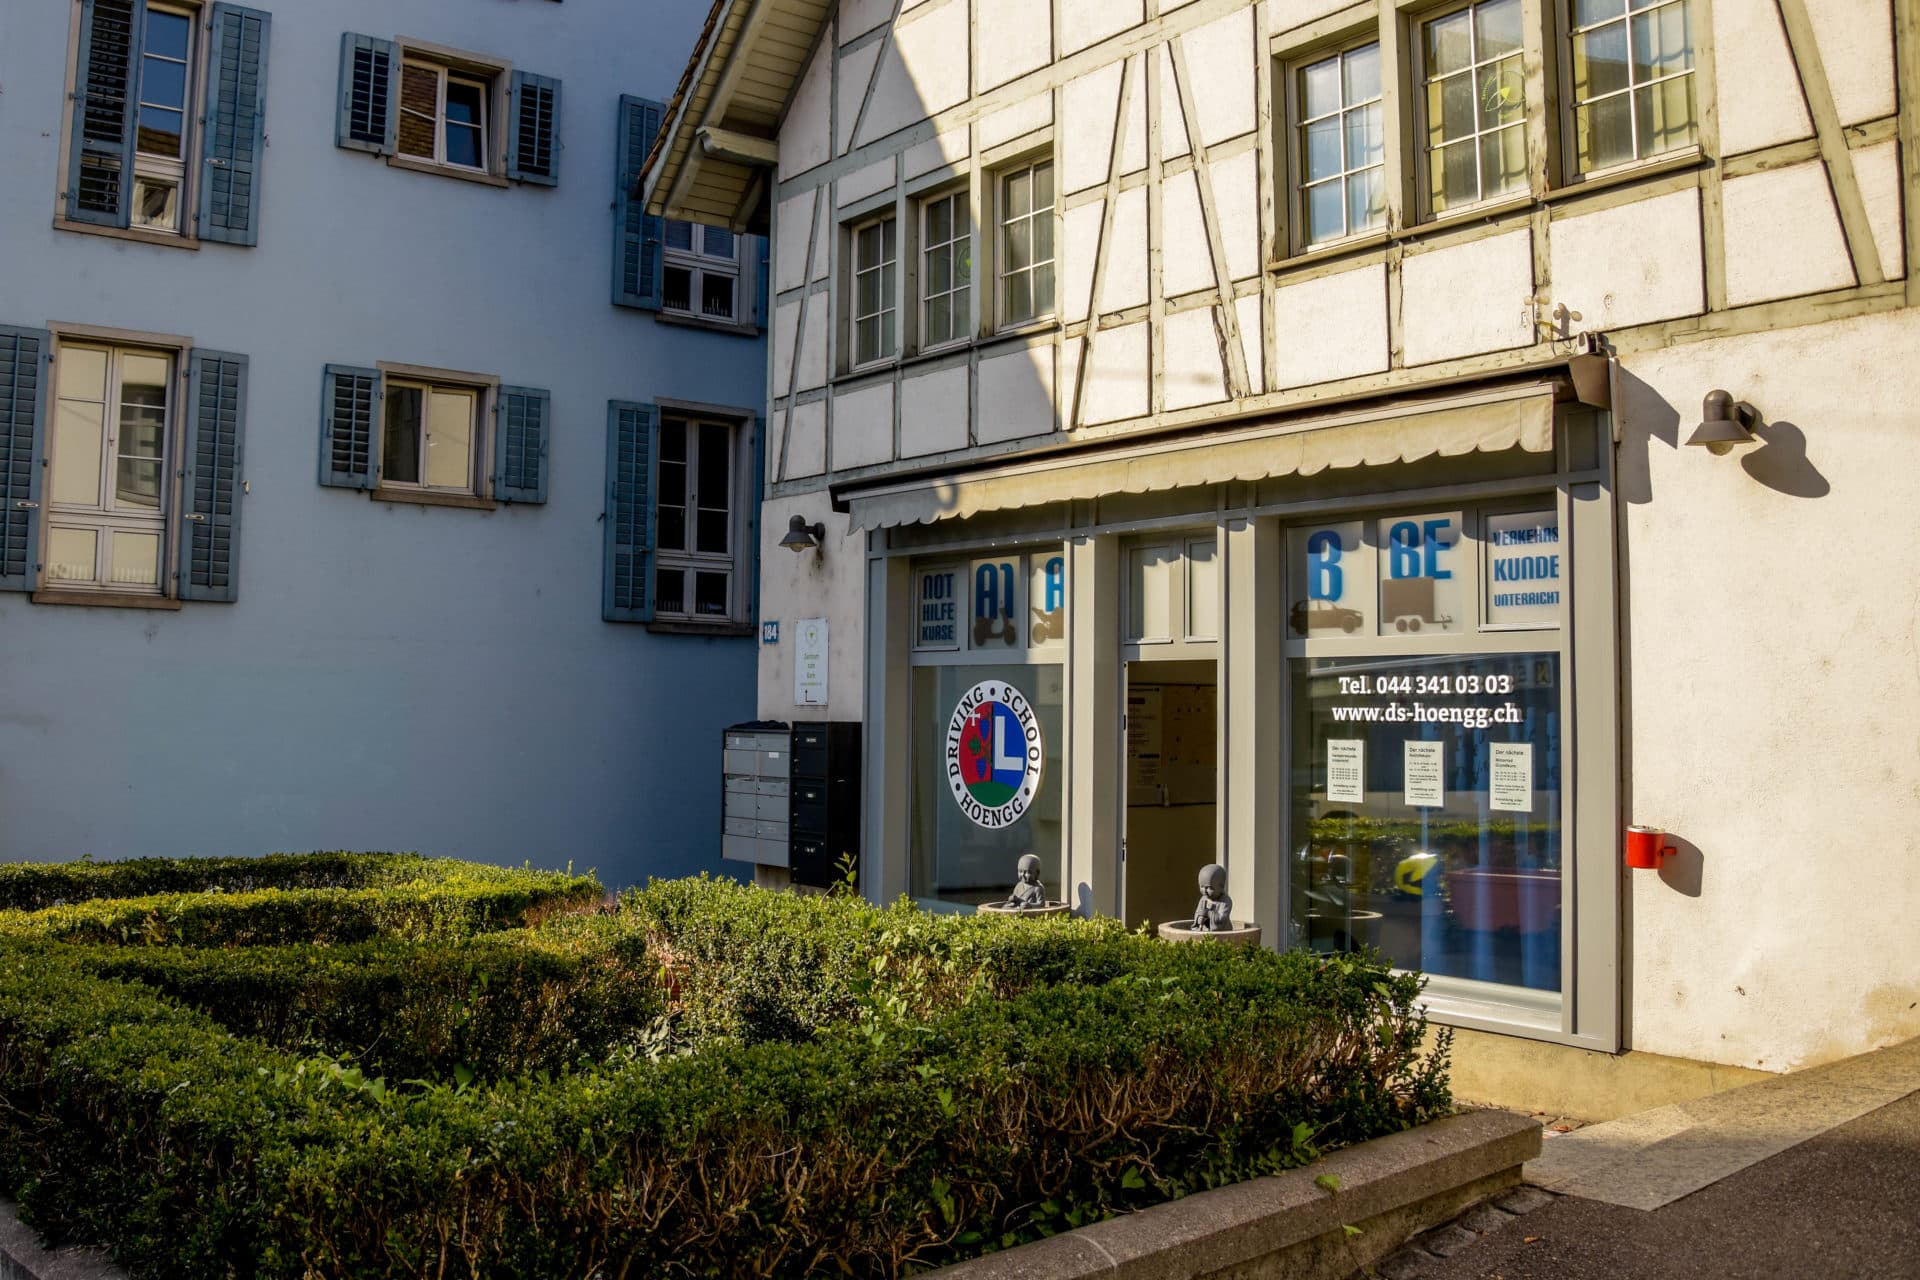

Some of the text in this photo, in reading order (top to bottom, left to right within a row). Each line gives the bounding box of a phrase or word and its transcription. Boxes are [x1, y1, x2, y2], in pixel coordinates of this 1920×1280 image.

[1390, 518, 1452, 580] BE
[1493, 525, 1559, 547] VERKEHRS
[1307, 529, 1343, 602] B
[1494, 554, 1560, 582] KUNDE
[923, 573, 954, 600] NOT
[975, 562, 1014, 619] A1
[1494, 591, 1560, 607] UNTERRICHT
[922, 602, 955, 622] HILFE
[764, 624, 777, 640] 184
[921, 624, 954, 641] KURSE
[1339, 674, 1510, 695] Tel. 044 341 03 03
[1332, 702, 1520, 728] www.ds-hoengg.ch
[948, 686, 984, 778] DRIVING
[994, 715, 1024, 771] L
[1002, 687, 1040, 776] SCHOOL
[960, 791, 1024, 827] HOENGG
